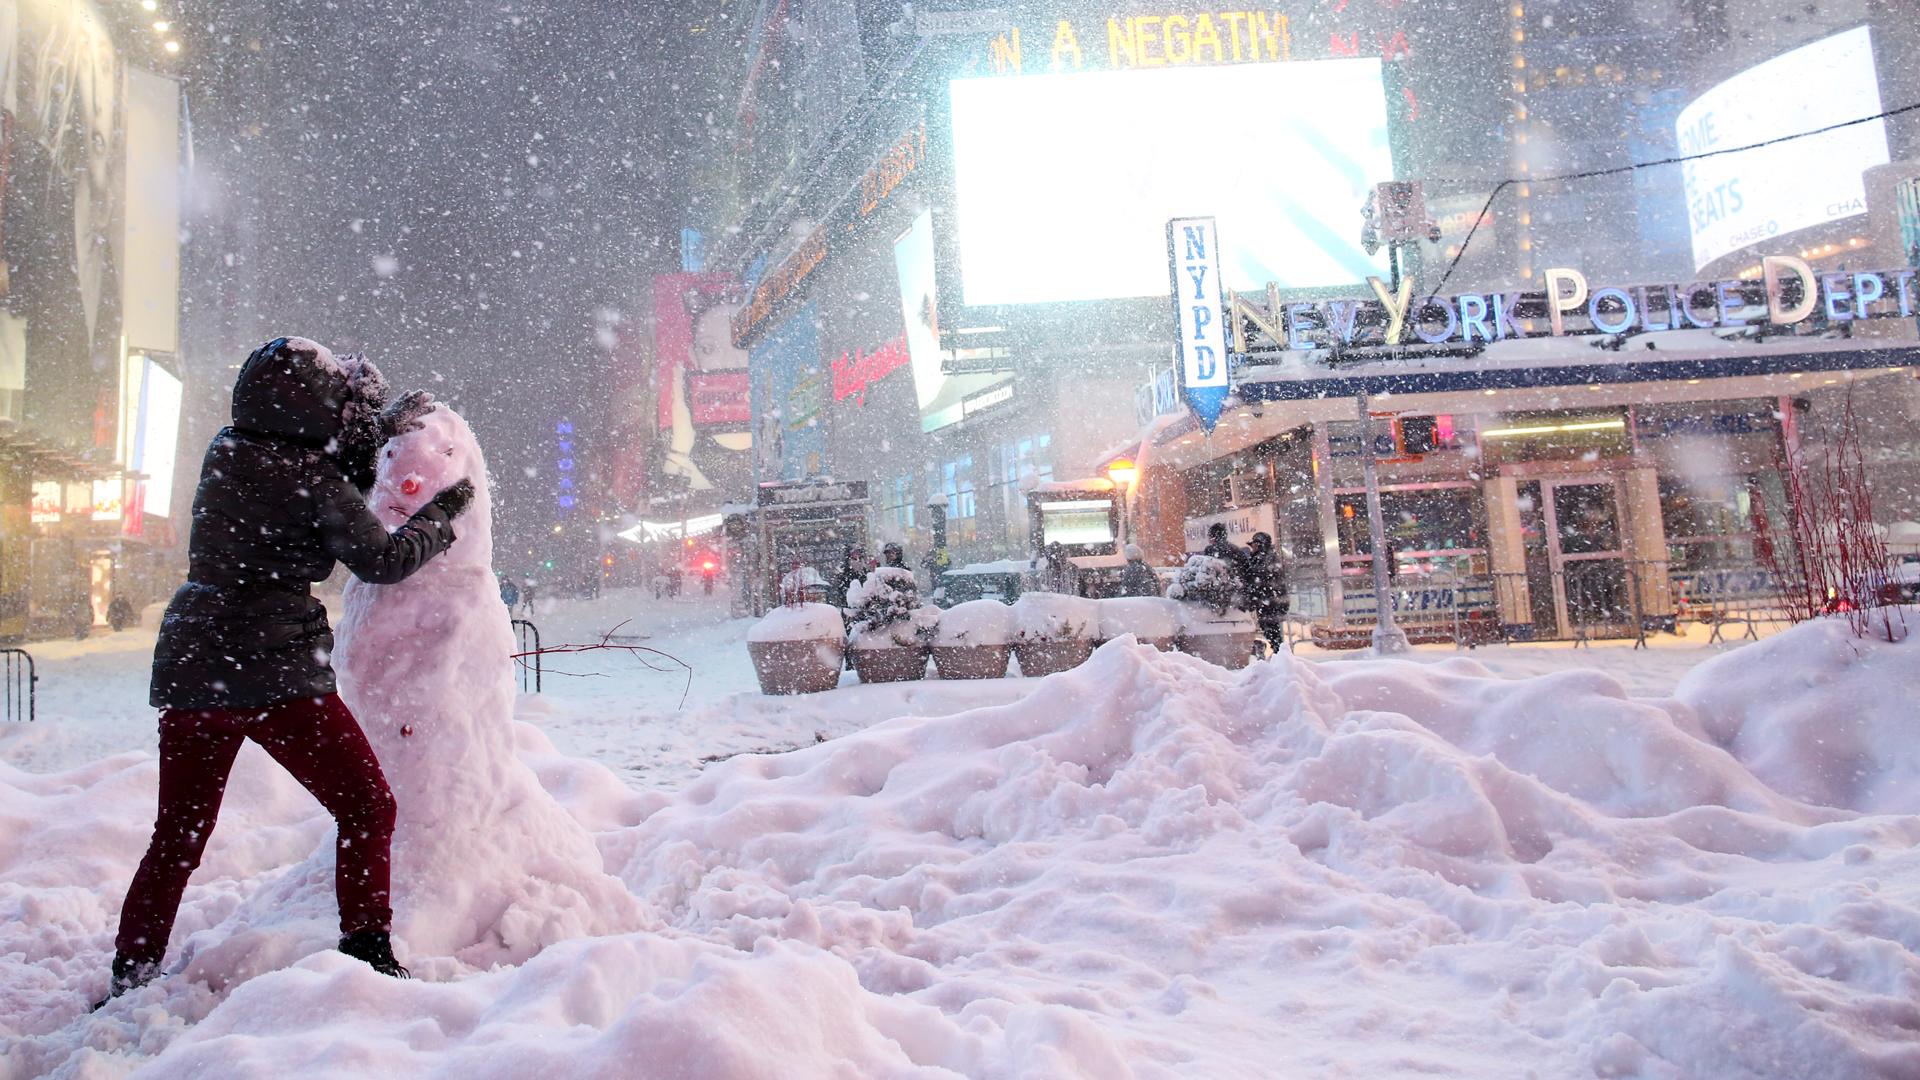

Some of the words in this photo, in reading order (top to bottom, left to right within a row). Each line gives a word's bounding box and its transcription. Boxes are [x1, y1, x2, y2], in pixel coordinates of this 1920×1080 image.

[1051, 18, 1081, 70] A
[1730, 227, 1764, 248] CHASE
[1183, 226, 1216, 380] NYPD
